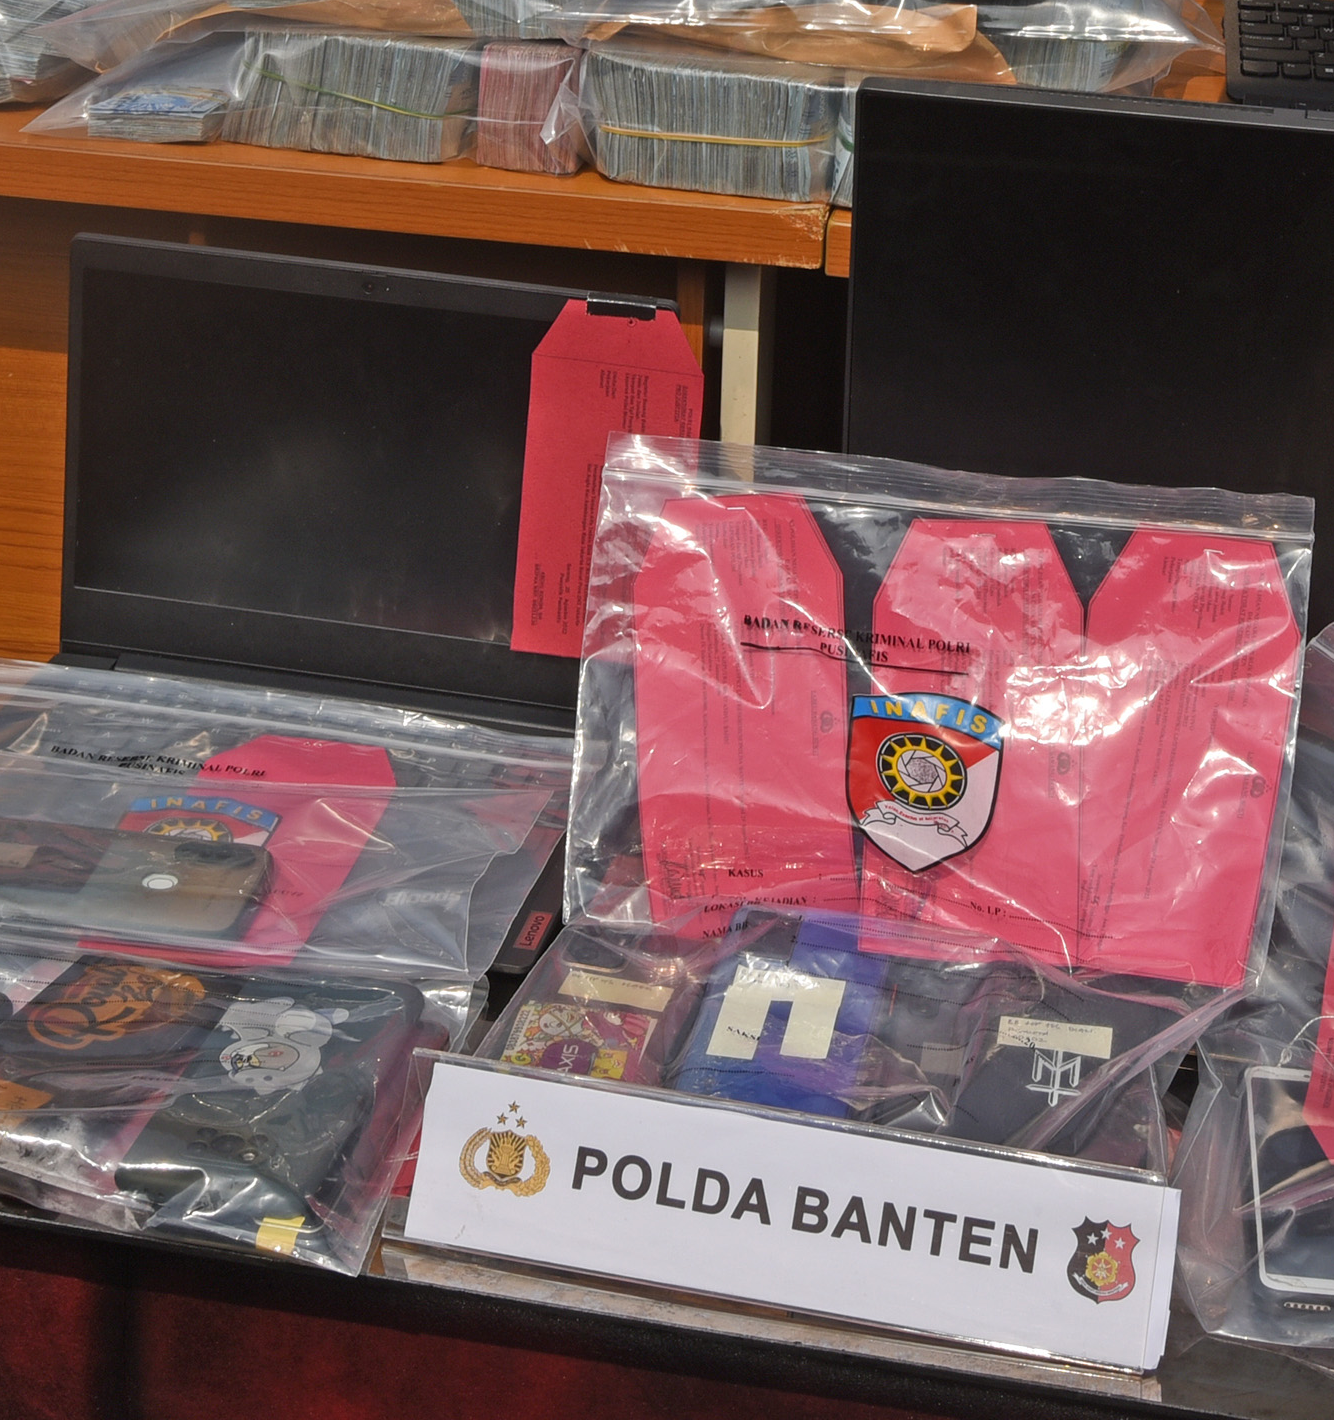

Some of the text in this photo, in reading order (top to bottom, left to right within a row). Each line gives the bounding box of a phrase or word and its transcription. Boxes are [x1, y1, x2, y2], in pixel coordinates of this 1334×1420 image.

[744, 614, 788, 630] BADAN
[856, 631, 924, 650] KRIMINAL
[928, 638, 970, 654] POLRI
[870, 699, 988, 733] INAFIS
[51, 745, 94, 761] BADAN
[225, 765, 266, 777] POLRI
[151, 797, 263, 821] INAFIS
[728, 869, 763, 879] KASUS
[519, 915, 545, 948] Lenovo
[571, 1145, 1039, 1274] POLDA BANTEN
